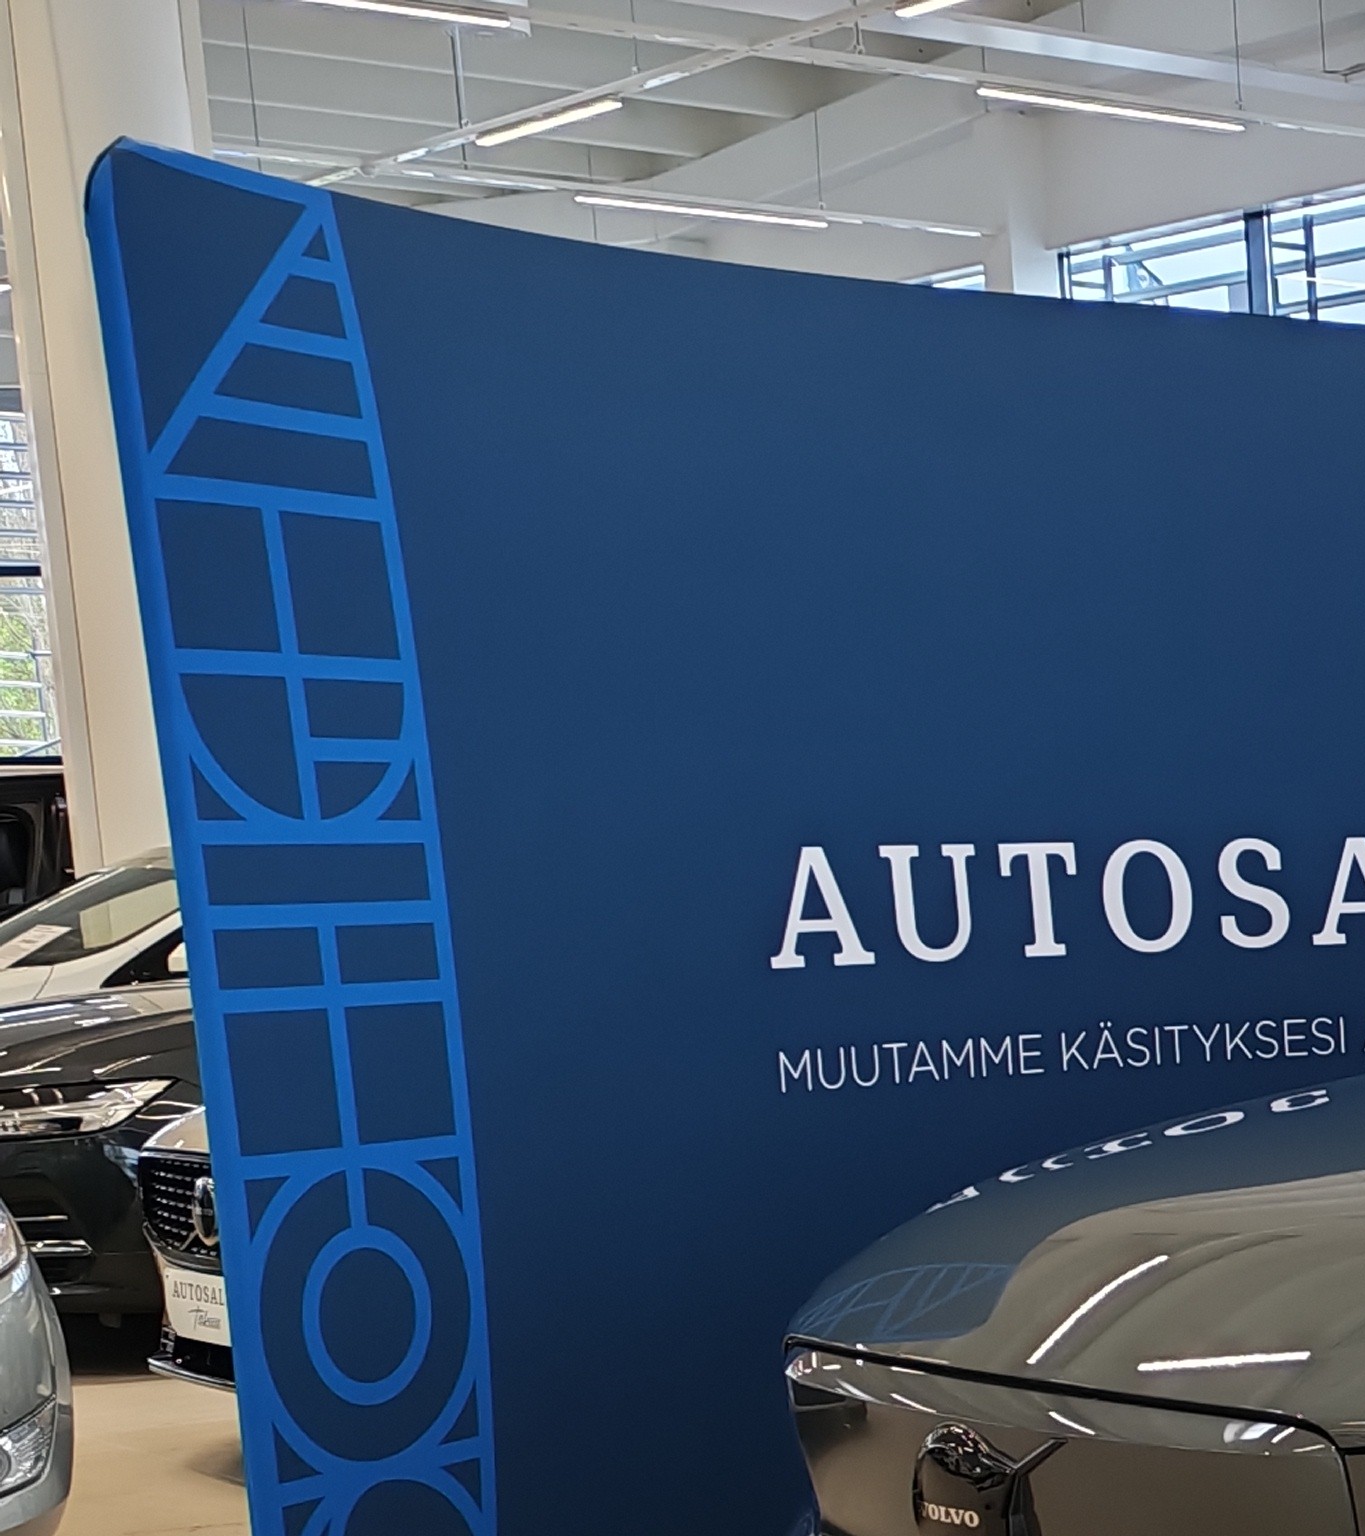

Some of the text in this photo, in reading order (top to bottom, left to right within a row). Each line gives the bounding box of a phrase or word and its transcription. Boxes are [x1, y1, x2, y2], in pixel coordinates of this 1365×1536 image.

[777, 1031, 1045, 1093] MUUTAMME
[1060, 1016, 1346, 1072] KÄSITYKSESI
[921, 1501, 980, 1528] VOLVO
